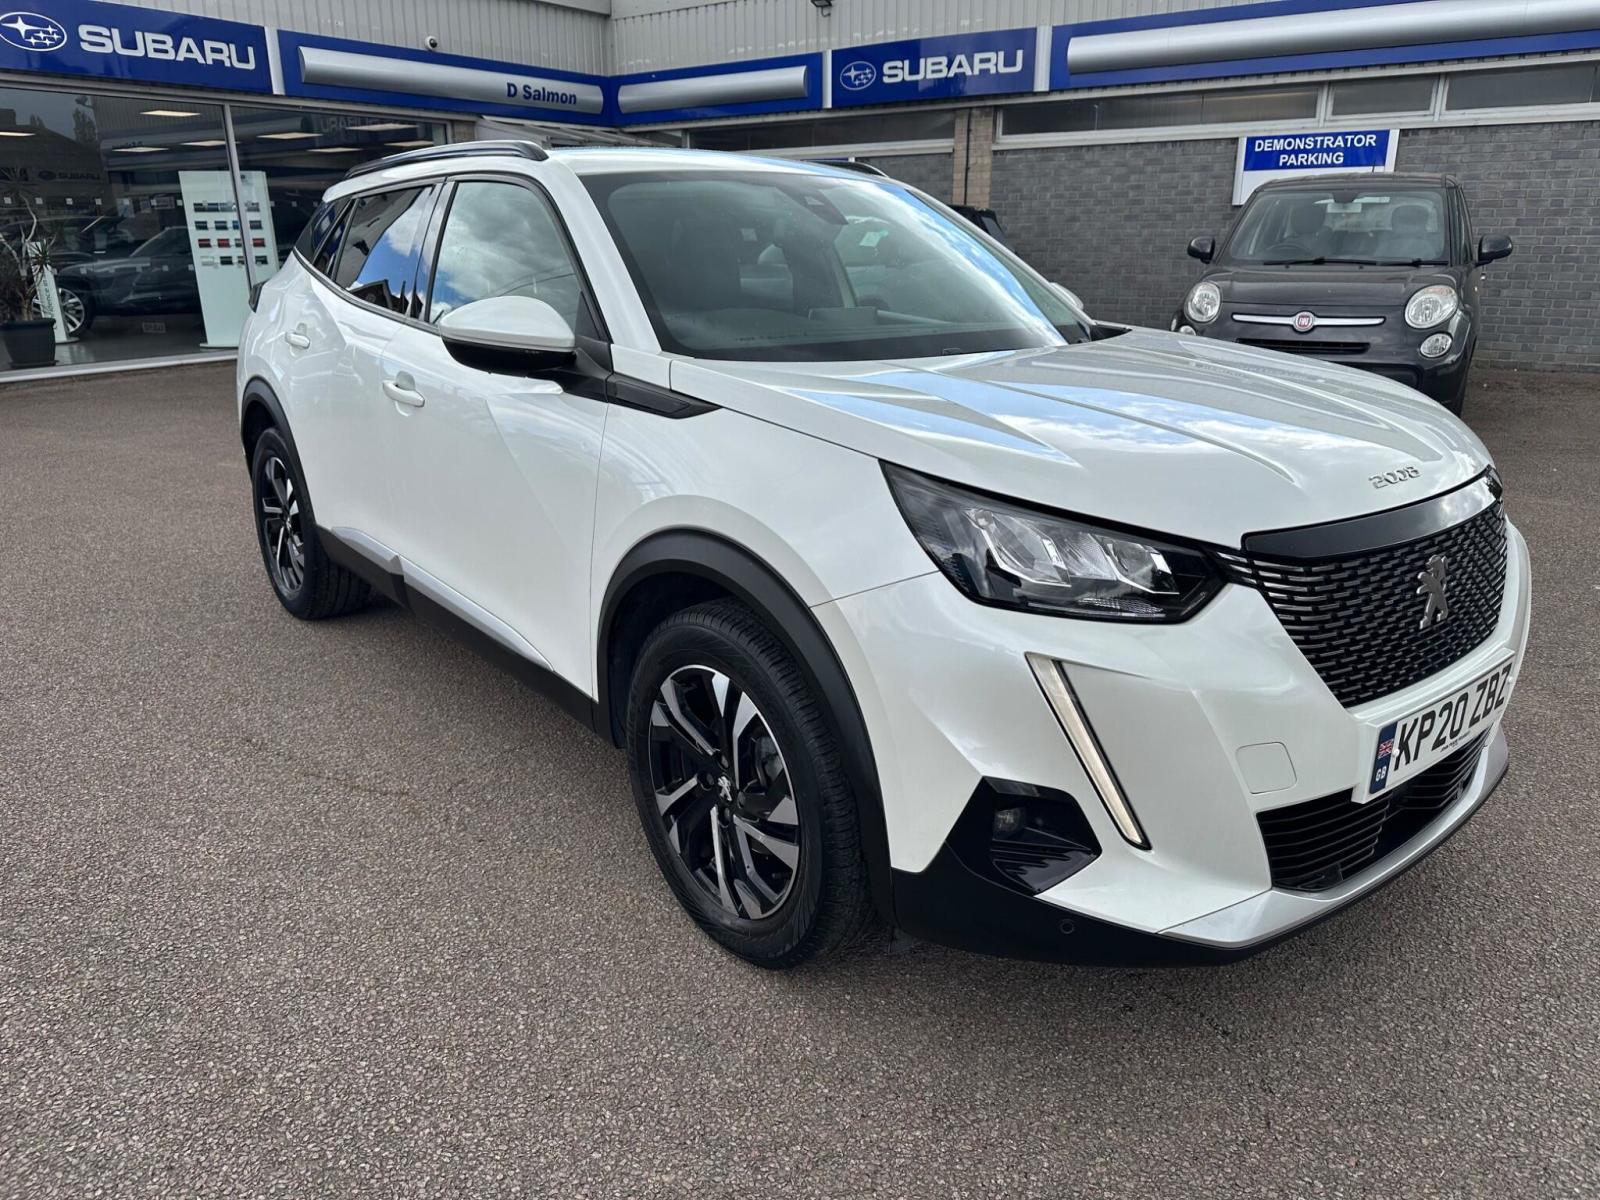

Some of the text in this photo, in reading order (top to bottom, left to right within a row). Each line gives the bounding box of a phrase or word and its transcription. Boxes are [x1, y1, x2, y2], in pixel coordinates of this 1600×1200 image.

[78, 25, 256, 70] SUBARU
[883, 49, 1023, 84] SUBARU
[507, 82, 577, 105] D Salmon
[1255, 134, 1377, 152] DEMONSTRATOR
[1279, 152, 1344, 166] PARKING
[1368, 466, 1421, 489] 2008
[1394, 662, 1512, 772] KP20 ZBZ
[1375, 765, 1387, 782] GB
